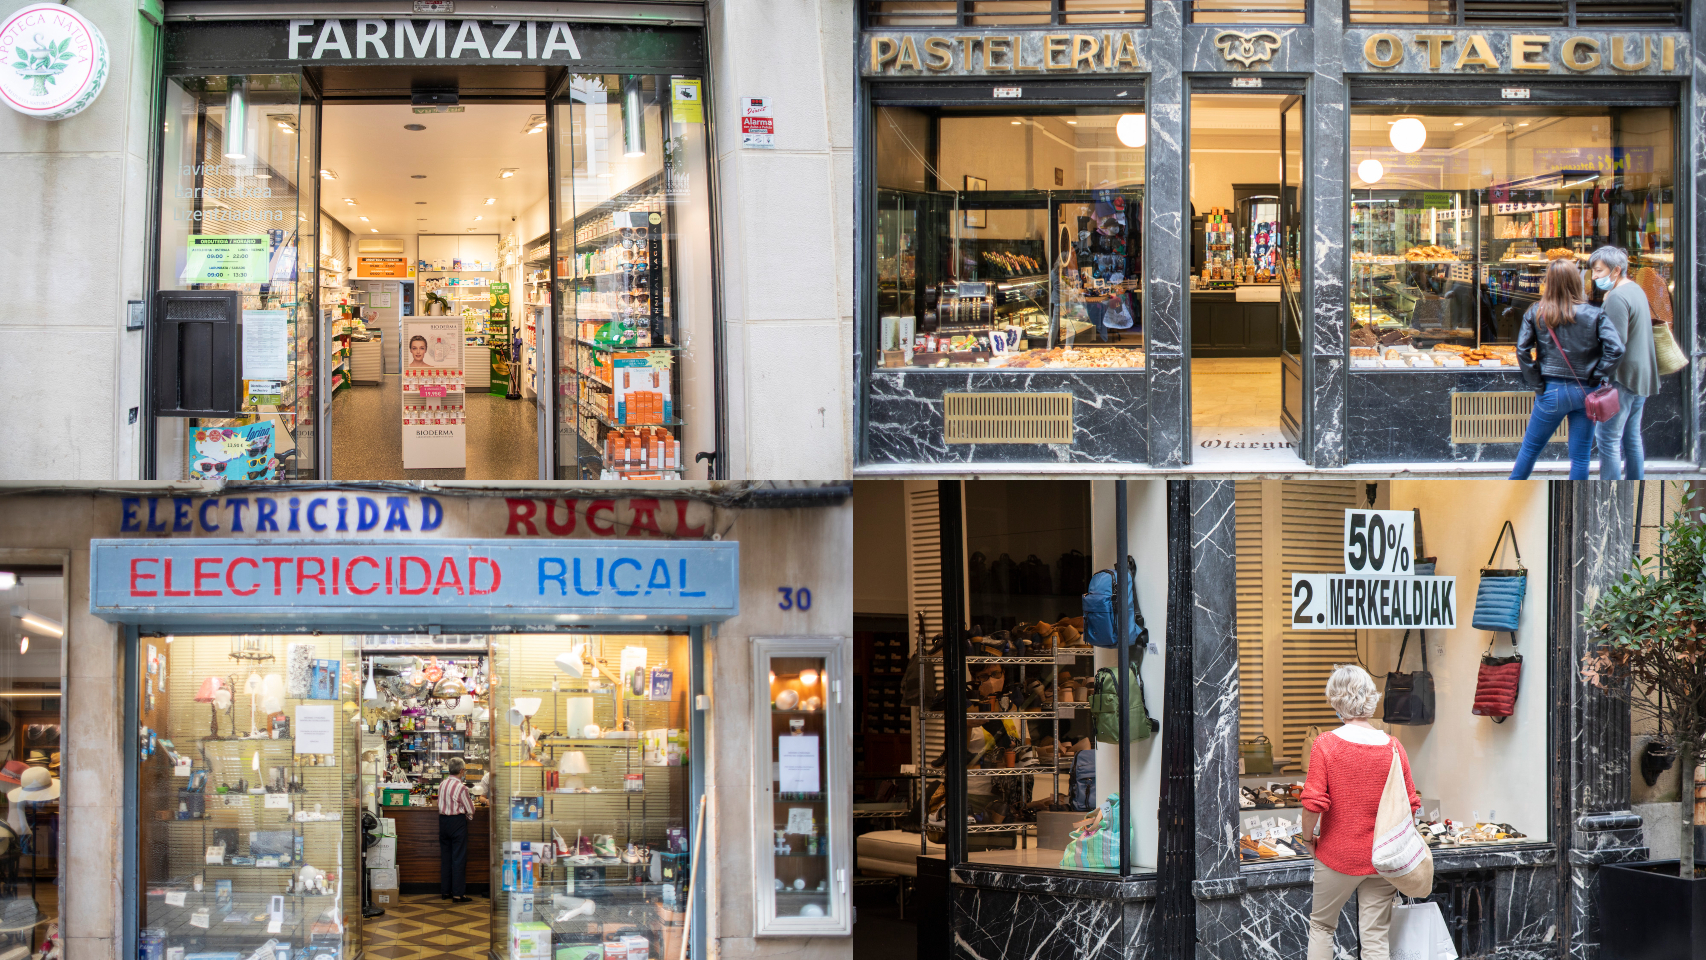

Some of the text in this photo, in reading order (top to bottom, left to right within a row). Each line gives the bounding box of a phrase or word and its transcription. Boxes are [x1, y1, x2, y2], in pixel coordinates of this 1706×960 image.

[0, 14, 88, 65] APOTECA NATURA
[288, 19, 582, 59] FARMAZIA
[871, 33, 1141, 71] PASTELERIA
[1363, 33, 1676, 71] OTAEGUI
[174, 185, 272, 198] Barrenetxea
[174, 207, 282, 221] Lizentziaduna
[1200, 440, 1294, 450] Otaegu
[504, 498, 706, 537] RUCAL
[1348, 514, 1409, 572] 50%
[130, 556, 502, 598] ELECTRICIDAD
[538, 557, 706, 598] RUCAL
[778, 587, 812, 610] 30
[1294, 578, 1454, 626] 2. MERKEALDIAK
